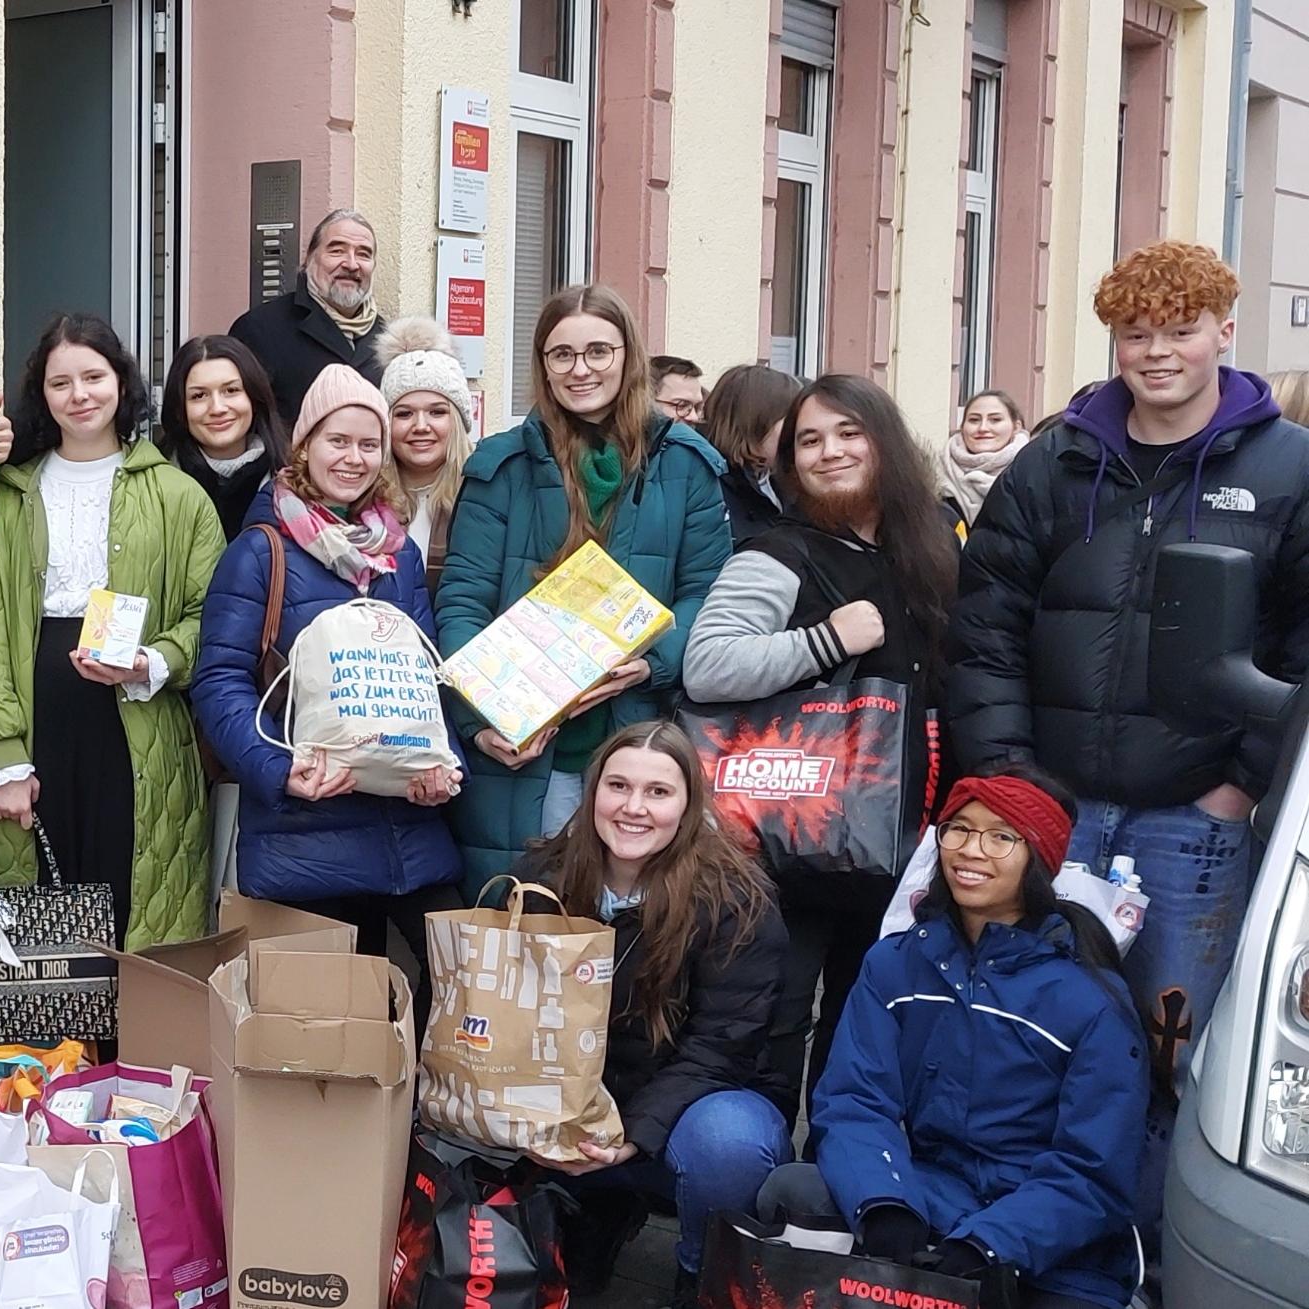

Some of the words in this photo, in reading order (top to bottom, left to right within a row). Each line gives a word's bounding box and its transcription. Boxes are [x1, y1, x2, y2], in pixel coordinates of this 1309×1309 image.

[1202, 493, 1238, 503] NORTH
[1219, 486, 1239, 496] THE
[1212, 500, 1238, 511] FACE
[801, 696, 896, 713] WOOLWORTH
[724, 758, 822, 779] HOME
[723, 776, 818, 791] DISCOUNT
[42, 960, 70, 979] DIOR
[245, 1274, 341, 1301] babylove
